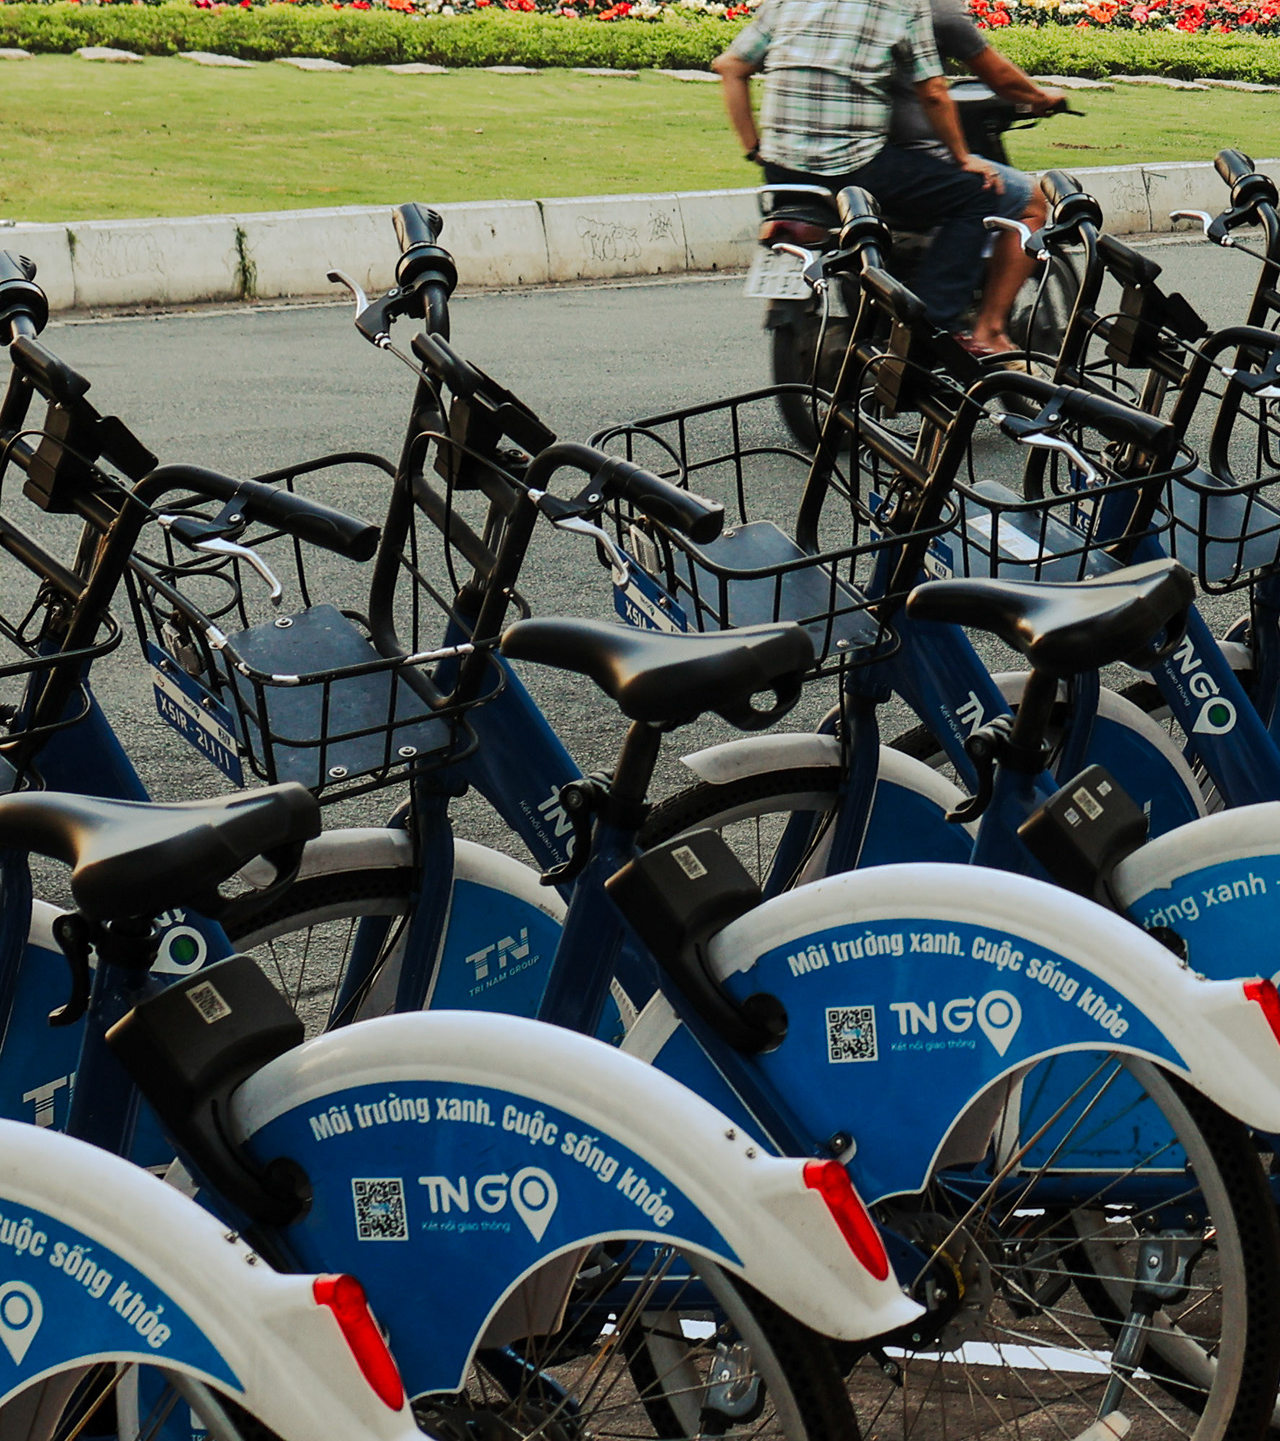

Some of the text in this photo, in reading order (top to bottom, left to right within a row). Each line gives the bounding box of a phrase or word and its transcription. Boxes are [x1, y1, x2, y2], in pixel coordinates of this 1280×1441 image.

[1204, 872, 1268, 907] xanh
[787, 929, 1130, 1040] Môi trường xanh. Cuộc sống khỏe
[309, 1091, 675, 1229] Môi trường xanh. Cuộc sống khỏe
[49, 1244, 173, 1349] sống khỏe
